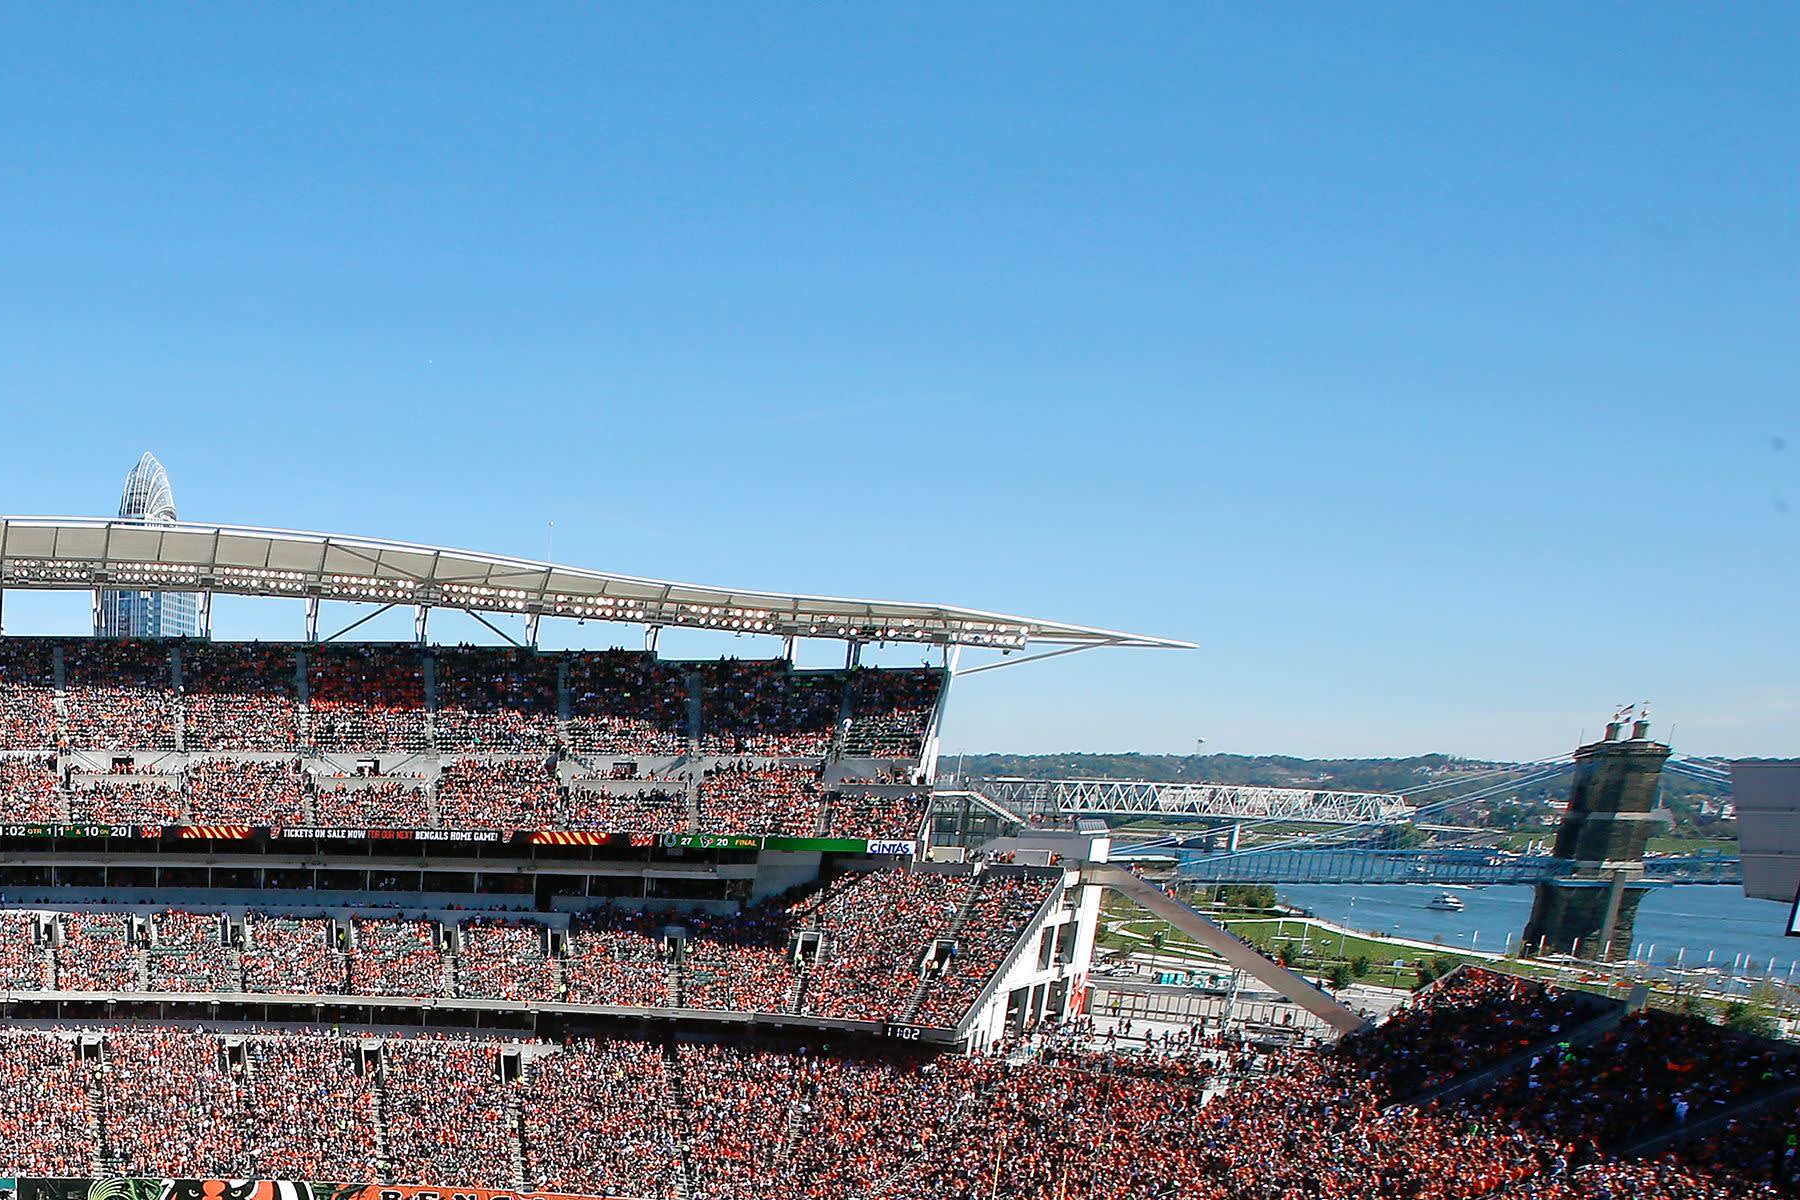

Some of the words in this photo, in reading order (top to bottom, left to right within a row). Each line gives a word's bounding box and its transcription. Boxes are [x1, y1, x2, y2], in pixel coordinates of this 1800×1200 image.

[84, 825, 99, 837] 10
[110, 825, 127, 837] 20
[283, 829, 313, 839] TICKETS
[314, 829, 326, 839] ON
[327, 829, 347, 839] SALE
[347, 830, 366, 840] NOW
[415, 831, 449, 840] BENGALS
[450, 831, 472, 841] HOME
[473, 832, 498, 842] GAME!
[680, 837, 693, 846] 27
[716, 837, 729, 846] 20
[734, 838, 757, 847] FINAL
[887, 1026, 920, 1040] 11:02
